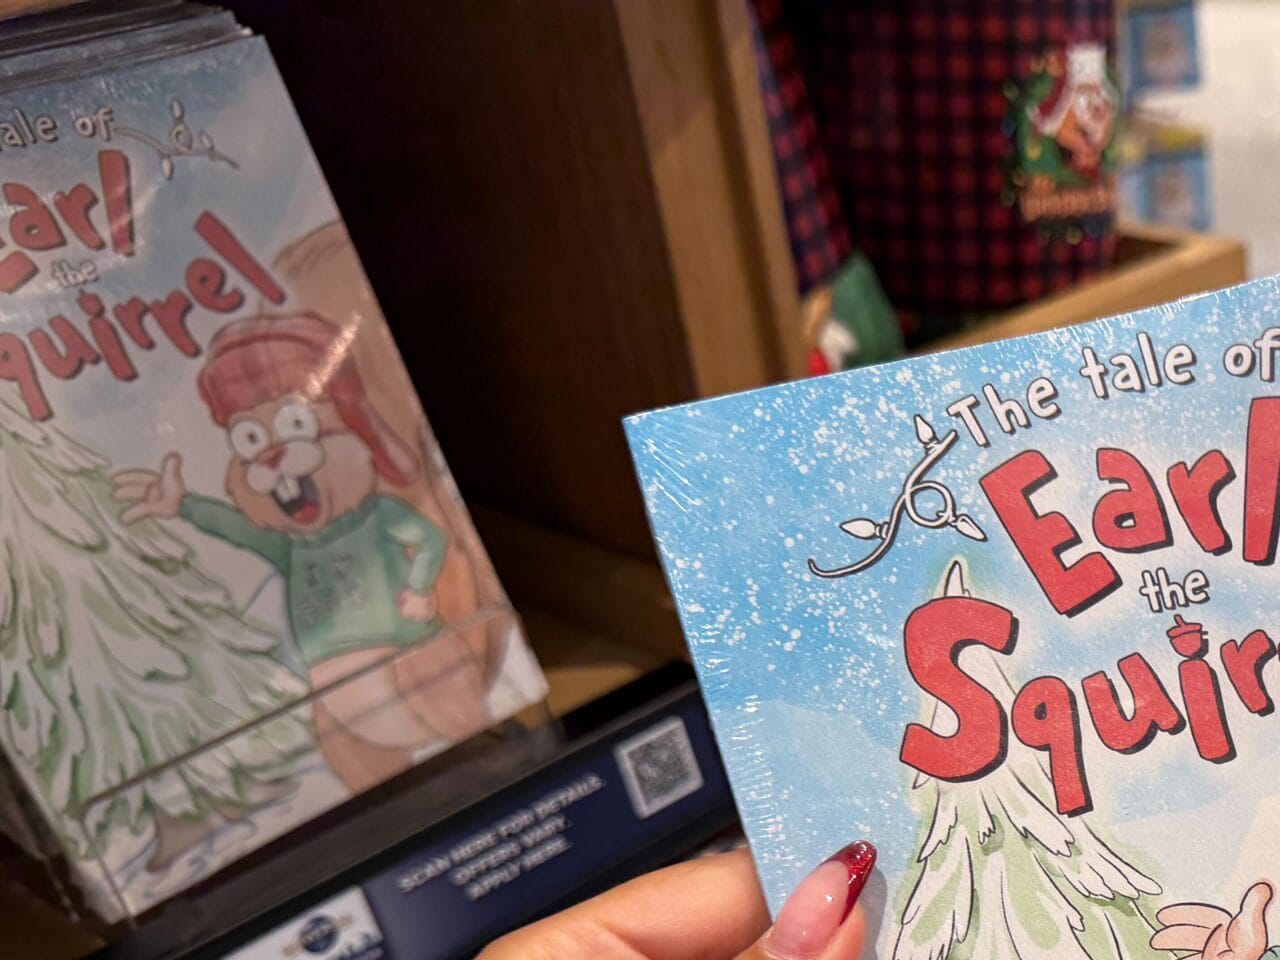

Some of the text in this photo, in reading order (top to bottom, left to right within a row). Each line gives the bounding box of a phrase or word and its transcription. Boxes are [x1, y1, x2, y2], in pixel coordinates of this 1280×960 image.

[0, 106, 115, 151] ale of
[51, 258, 100, 289] the
[0, 210, 288, 422] quirrel
[948, 376, 1063, 448] The
[1080, 331, 1197, 400] tale
[1139, 566, 1210, 612] the
[398, 854, 450, 893] SCAN
[450, 828, 499, 864] HERE
[498, 808, 535, 840] FOR
